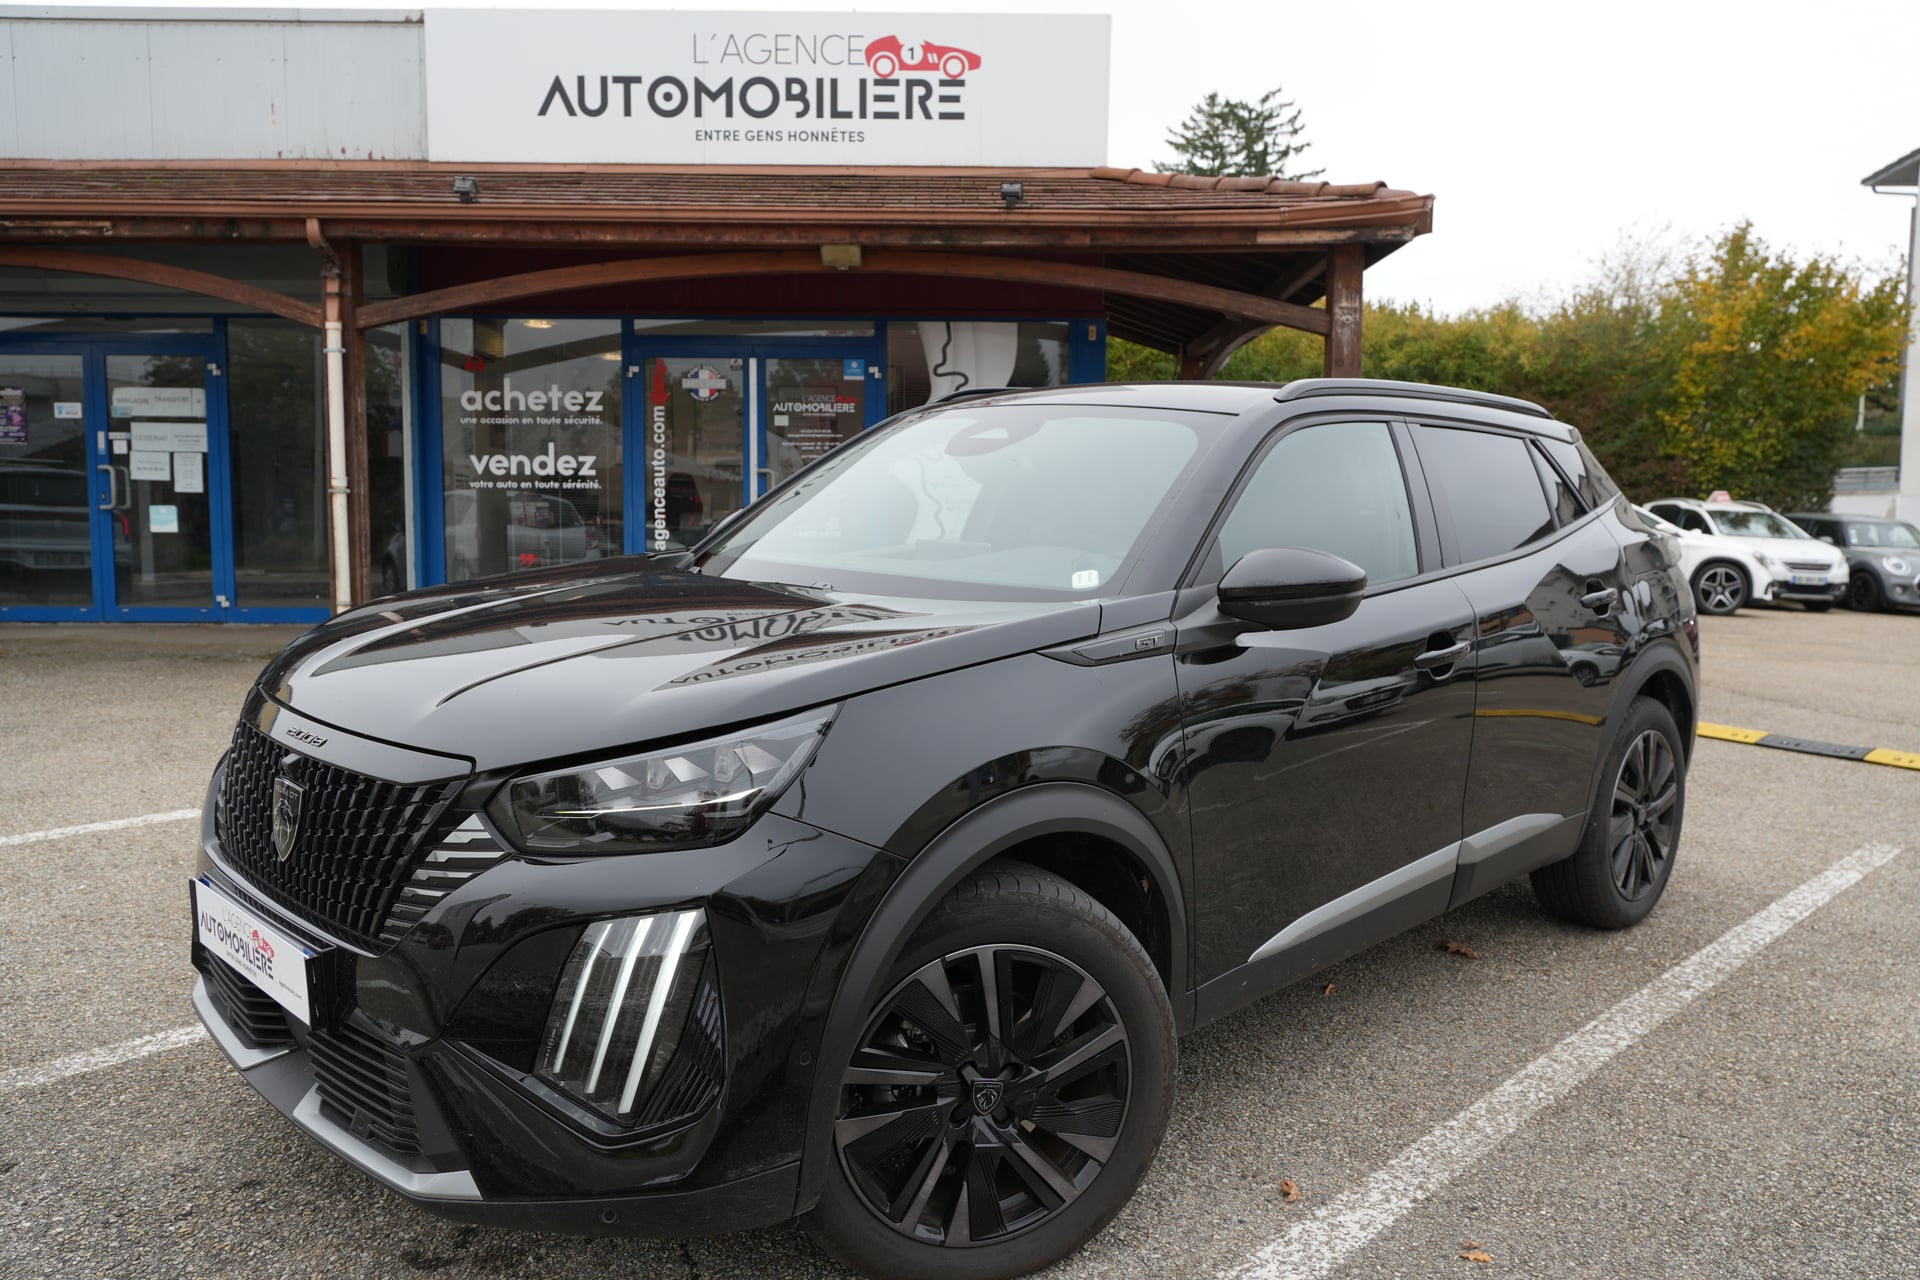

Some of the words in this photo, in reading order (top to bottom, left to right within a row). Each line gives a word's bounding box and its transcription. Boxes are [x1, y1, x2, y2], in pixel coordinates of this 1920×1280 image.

[693, 33, 865, 66] L'AGENCE
[908, 47, 916, 61] 1
[537, 75, 966, 120] AUTOMOBILIERE
[695, 130, 741, 142] ENTRE
[744, 130, 784, 142] GENS
[787, 127, 866, 143] HONNÊTES
[460, 377, 604, 412] achetez
[772, 402, 856, 413] AUTOMOBILIERE
[802, 394, 836, 402] L'AGENCE
[460, 417, 477, 425] une
[480, 415, 520, 425] occasion
[522, 417, 534, 425] en
[536, 416, 562, 425] toute
[564, 414, 604, 425] sécurité.
[469, 442, 597, 477] vendez
[469, 481, 494, 489] votre
[496, 481, 518, 489] auto
[534, 480, 560, 489] toute
[562, 479, 602, 489] sérénité.
[651, 405, 671, 551] agenceauto.com
[286, 726, 329, 748] 2008
[222, 907, 254, 940] L'AGENCE
[200, 910, 274, 981] AUTOMOBILIERE
